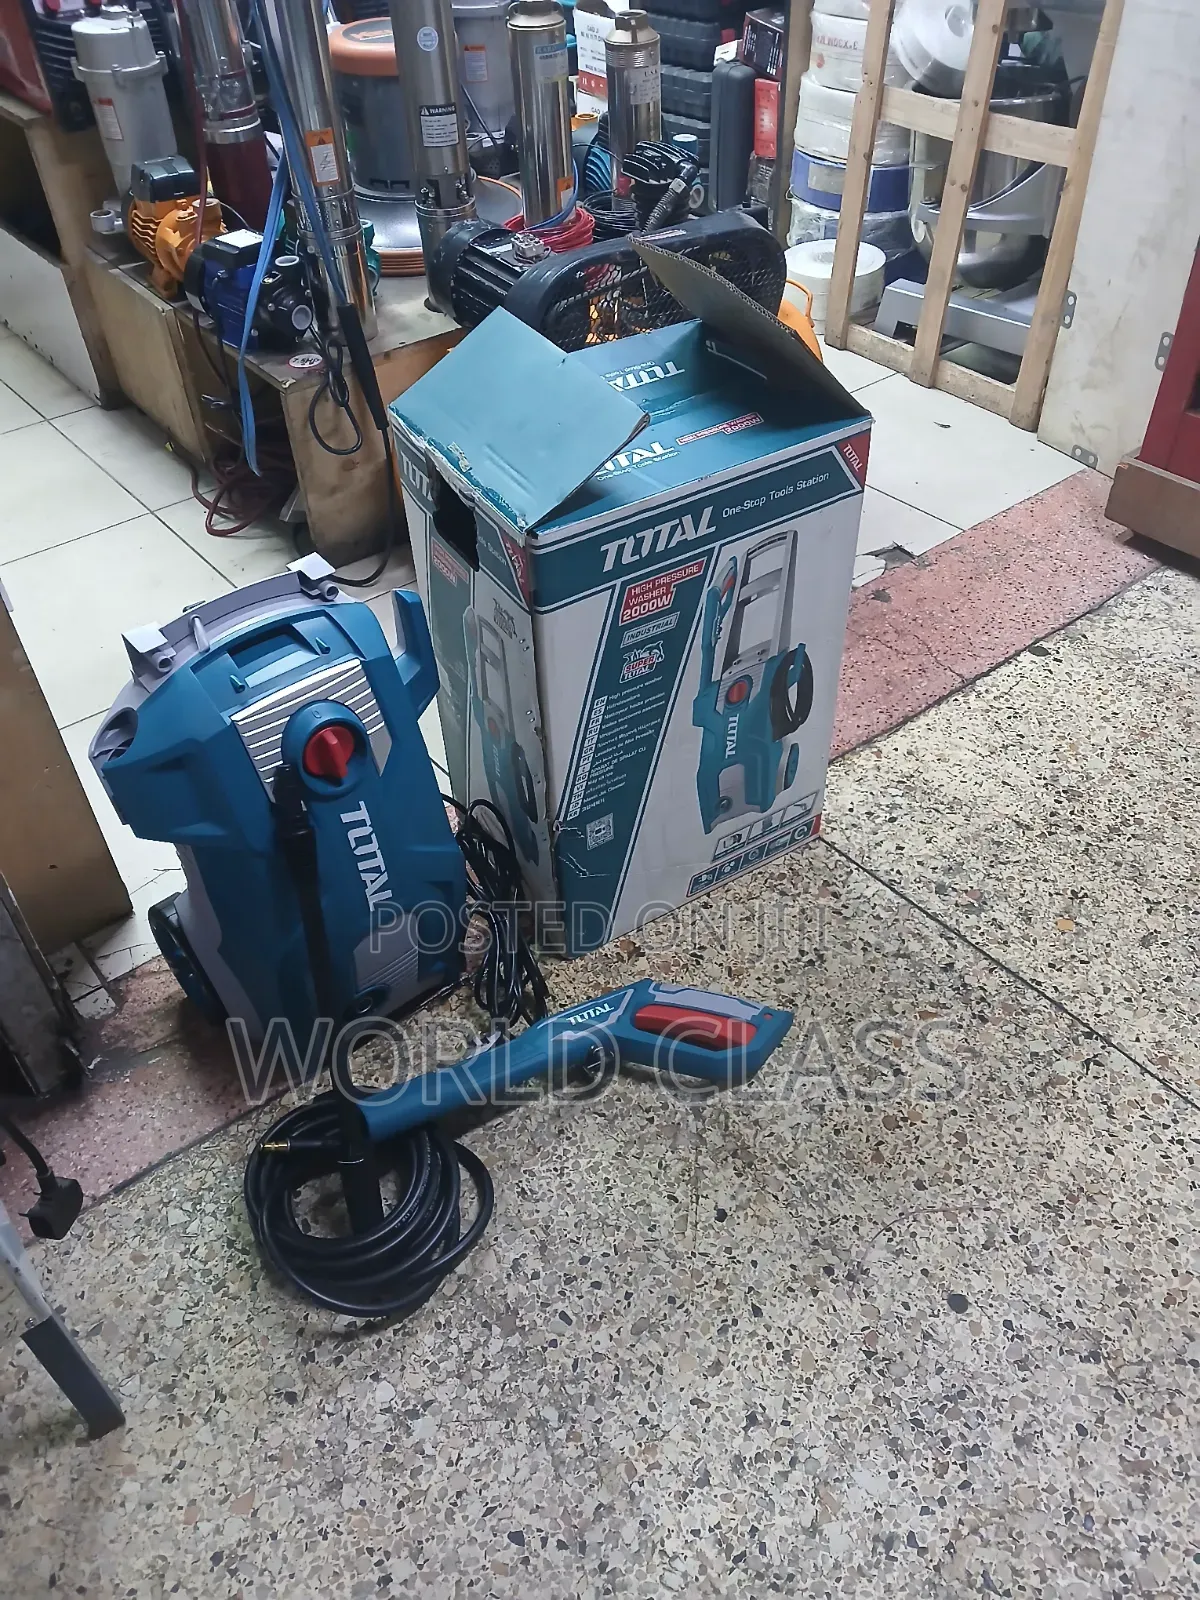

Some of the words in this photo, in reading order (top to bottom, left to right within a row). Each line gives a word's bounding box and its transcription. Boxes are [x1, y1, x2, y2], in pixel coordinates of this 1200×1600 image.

[429, 105, 455, 114] WARNING
[607, 361, 685, 392] TOTA
[725, 417, 760, 433] 2000W
[595, 441, 675, 477] OTAL
[842, 443, 862, 472] TOTAL
[401, 452, 434, 502] TOT
[601, 506, 716, 573] TOTAL
[722, 496, 766, 518] One-Stop
[769, 485, 793, 501] Tools
[796, 472, 829, 490] Station
[631, 583, 652, 596] HIGH
[655, 565, 699, 587] PRESSURE
[623, 594, 671, 621] 2000W
[628, 586, 666, 606] WASHER
[628, 617, 675, 639] INDUSTRIAL
[624, 656, 655, 673] SUPER
[725, 713, 740, 760] TOTAL
[340, 800, 393, 912] TOTAL
[566, 1002, 615, 1026] TOTAL
